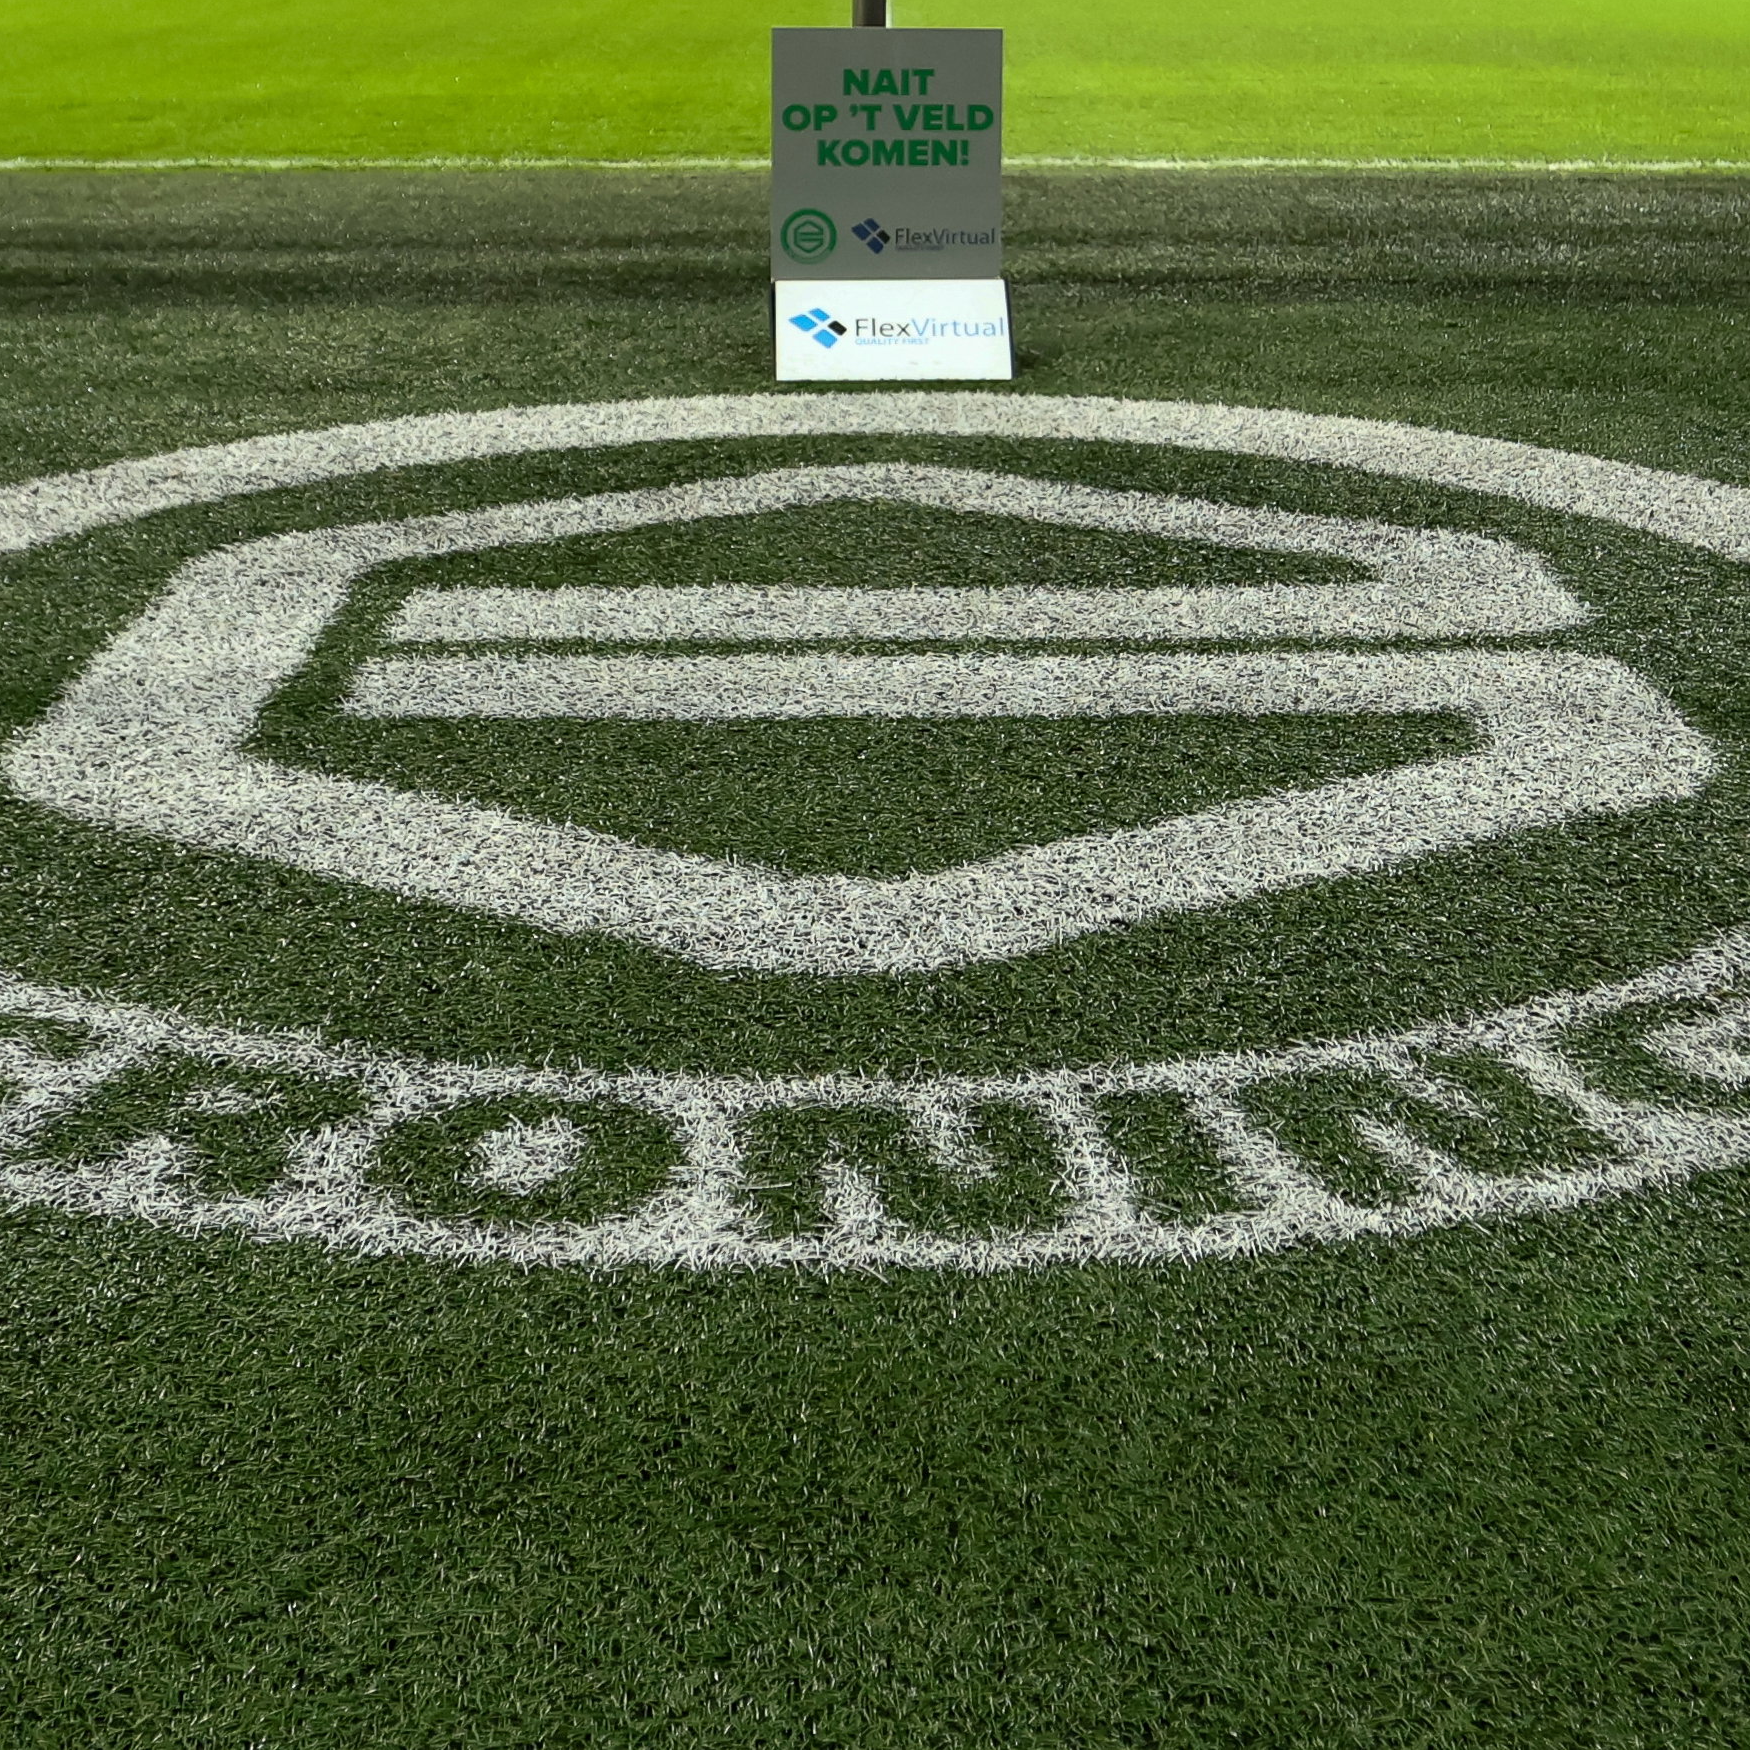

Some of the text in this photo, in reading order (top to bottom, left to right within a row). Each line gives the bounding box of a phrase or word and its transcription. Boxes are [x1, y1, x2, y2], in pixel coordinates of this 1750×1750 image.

[843, 68, 935, 96] NAIT
[781, 105, 838, 132] OP
[893, 104, 995, 131] VELD
[817, 139, 970, 167] KOMEN!
[894, 227, 996, 246] FlexVirtual
[855, 316, 1006, 338] FlexVirtual
[855, 338, 930, 346] QUALITY FIRST
